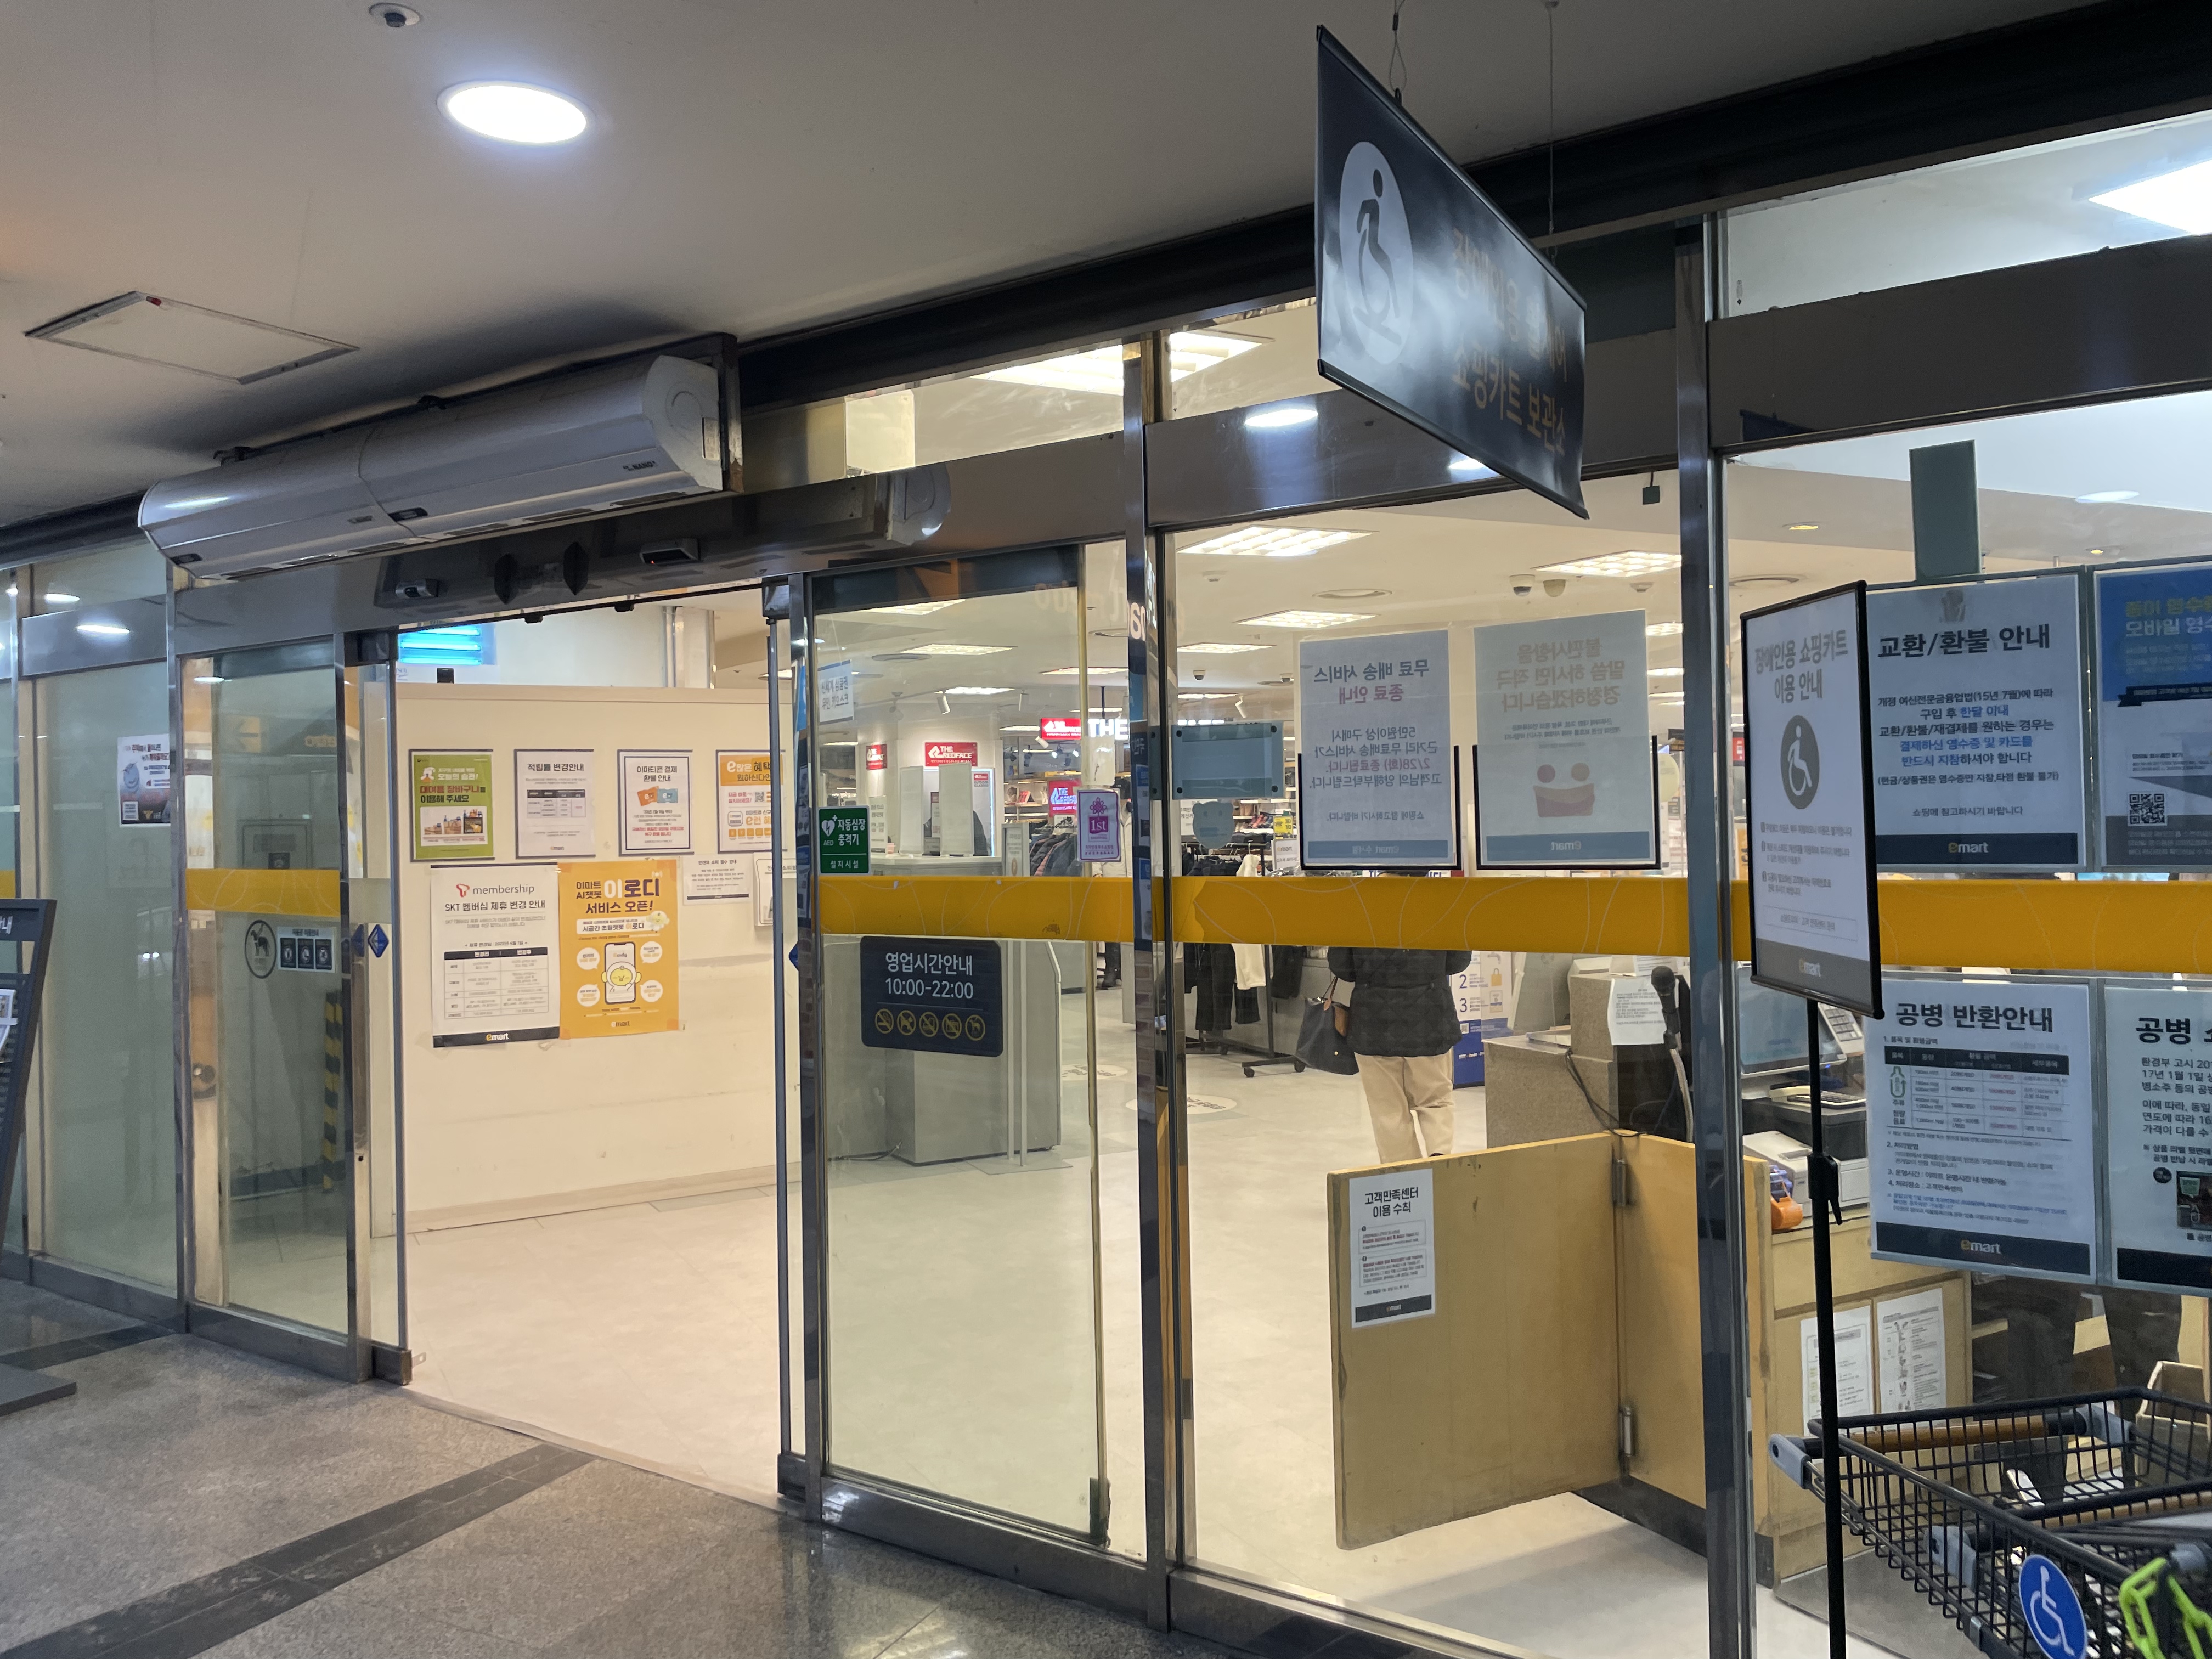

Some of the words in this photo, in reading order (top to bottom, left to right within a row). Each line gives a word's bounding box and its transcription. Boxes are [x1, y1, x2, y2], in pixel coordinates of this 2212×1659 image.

[1527, 383, 1565, 456] 보관소
[2125, 618, 2180, 637] 모바일
[1878, 628, 1990, 658] 교환/환불
[1999, 623, 2050, 651] 안내
[1754, 640, 1796, 674] 장애인용
[1799, 629, 1848, 664] 쇼핑카트
[1774, 674, 1795, 703] 이용
[1799, 668, 1822, 701] 안내
[1877, 697, 1896, 707] 개정
[2033, 688, 2053, 698] 따라
[1920, 708, 1942, 719] 구입
[1946, 707, 1957, 719] 후
[1960, 706, 1982, 718] 한달
[1986, 704, 2008, 717] 이내
[1088, 719, 1129, 740] THE
[1982, 720, 2017, 732] 원하는
[2019, 719, 2054, 731] 경우는
[1900, 739, 1943, 752] 결제하신
[1946, 737, 1980, 750] 영수증
[1984, 737, 1995, 748] 및
[1999, 735, 2033, 747] 카드를
[1902, 755, 1934, 767] 반드시
[1938, 753, 1994, 766] 지참하셔야
[1997, 752, 2032, 764] 합니다
[554, 763, 584, 771] 변경안내
[1912, 808, 1938, 817] 쇼핑에
[1942, 807, 1985, 816] 참고하시기
[1987, 806, 2023, 816] 바랍니다
[837, 819, 866, 831] 자동심장
[1091, 820, 1107, 831] 1st
[838, 834, 859, 845] 충격기
[1948, 842, 1988, 853] emart
[830, 860, 859, 869] 설치시설
[472, 884, 535, 895] membership
[576, 881, 601, 890] 이마트
[604, 878, 659, 898] 이로디
[463, 902, 488, 911] 멤버십
[491, 901, 507, 910] 제휴
[510, 901, 526, 910] 변경
[529, 900, 545, 909] 안내
[585, 902, 621, 914] 서비스
[625, 900, 653, 912] 오픈!
[885, 952, 972, 975] 영업시간안내
[1799, 958, 1821, 977] emart
[1459, 974, 1467, 988] 2
[885, 978, 974, 999] 10:00-22:00
[1460, 998, 1467, 1012] 3
[1896, 1003, 1943, 1027] 공병
[1953, 1005, 2053, 1032] 반환안내
[2136, 1017, 2191, 1045] 공병
[2142, 1057, 2170, 1067] 환경부
[2174, 1058, 2193, 1068] 고시
[2142, 1070, 2164, 1080] 17년
[2168, 1071, 2183, 1080] 1월
[2188, 1072, 2203, 1082] 1일
[2142, 1082, 2171, 1092] 병소주
[2175, 1084, 2194, 1093] 등의
[2142, 1100, 2162, 1109] 이에
[2191, 1102, 2210, 1113] 동일
[2142, 1112, 2172, 1122] 연도에
[2175, 1114, 2194, 1124] 따라
[2143, 1125, 2172, 1135] 가격이
[2198, 1128, 2209, 1137] 수
[1364, 1186, 1419, 1205] 고객만족센터
[1373, 1205, 1391, 1217] 이용
[1393, 1201, 1411, 1215] 수칙
[1961, 1239, 2001, 1255] emart
